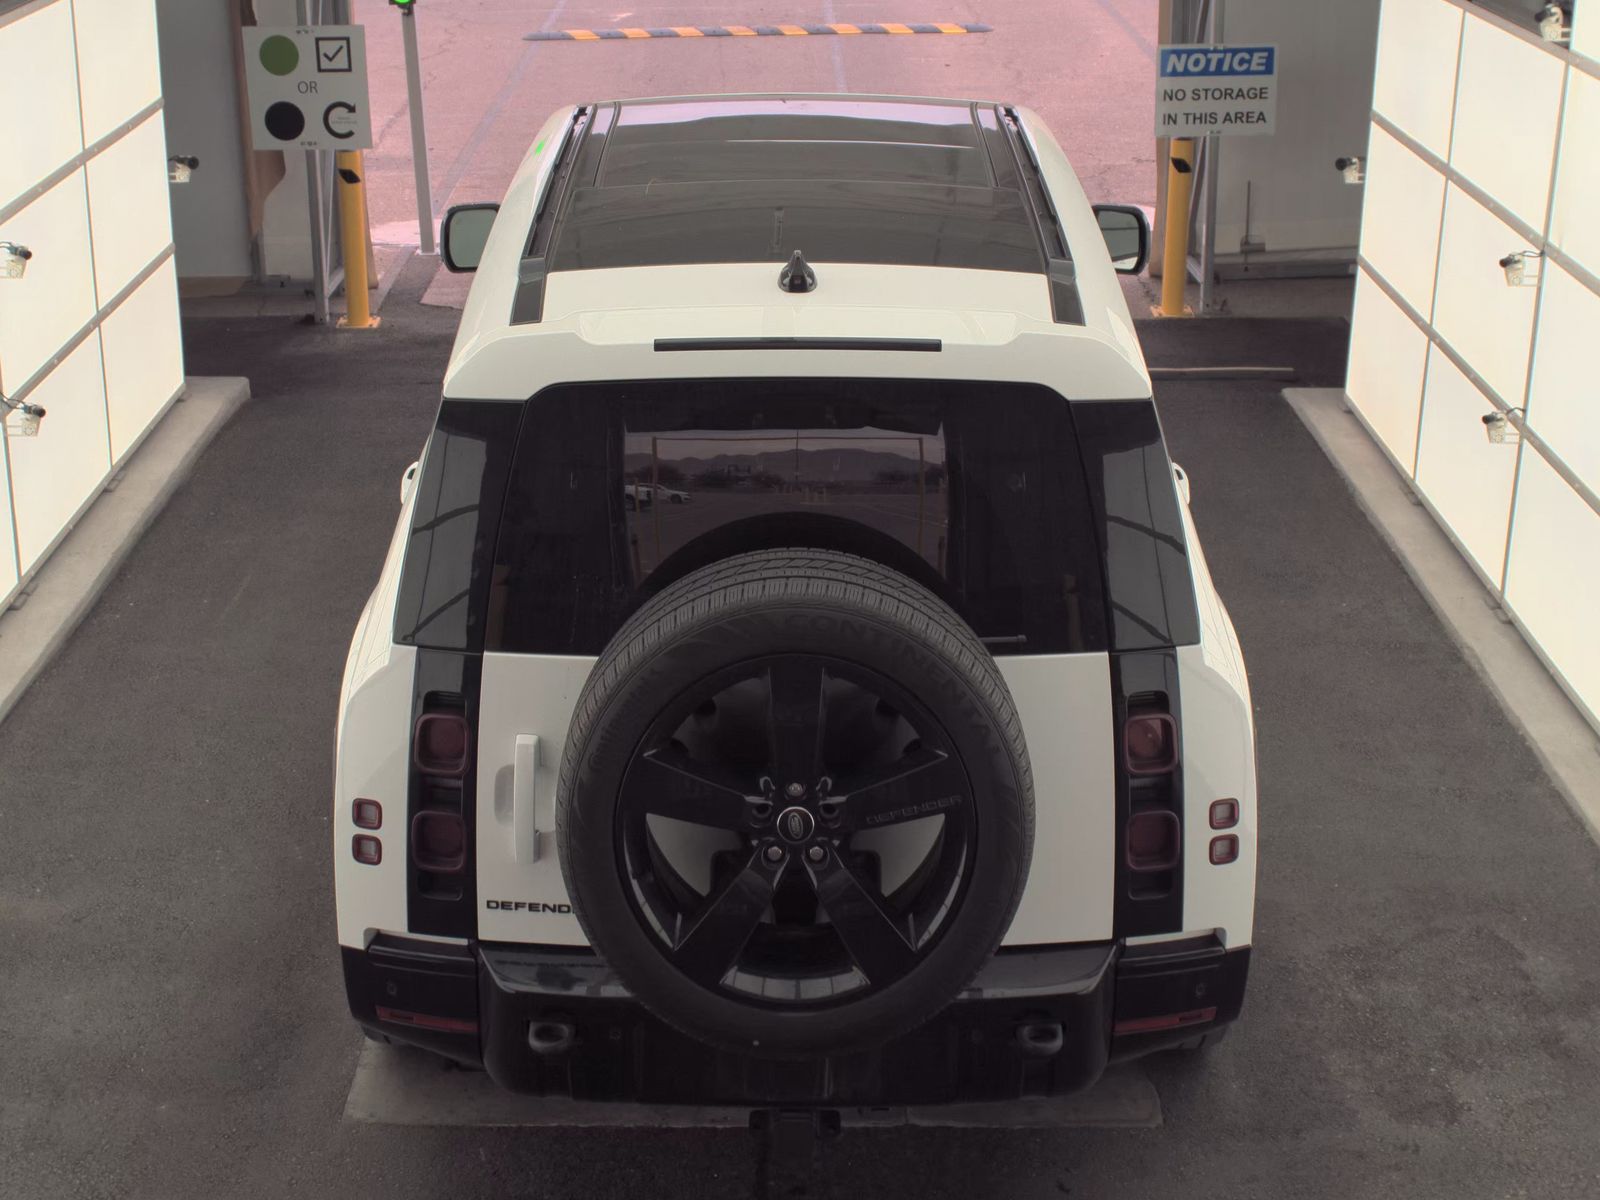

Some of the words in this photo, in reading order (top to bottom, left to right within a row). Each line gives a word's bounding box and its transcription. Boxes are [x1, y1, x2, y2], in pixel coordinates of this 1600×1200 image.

[1166, 52, 1269, 73] NOTICE
[297, 80, 318, 94] OR
[1163, 89, 1186, 101] NO
[1192, 87, 1269, 101] STORAGE
[1162, 114, 1178, 125] IN
[1183, 112, 1218, 125] THIS
[1222, 111, 1267, 124] AREA
[486, 900, 574, 914] DEFEND
